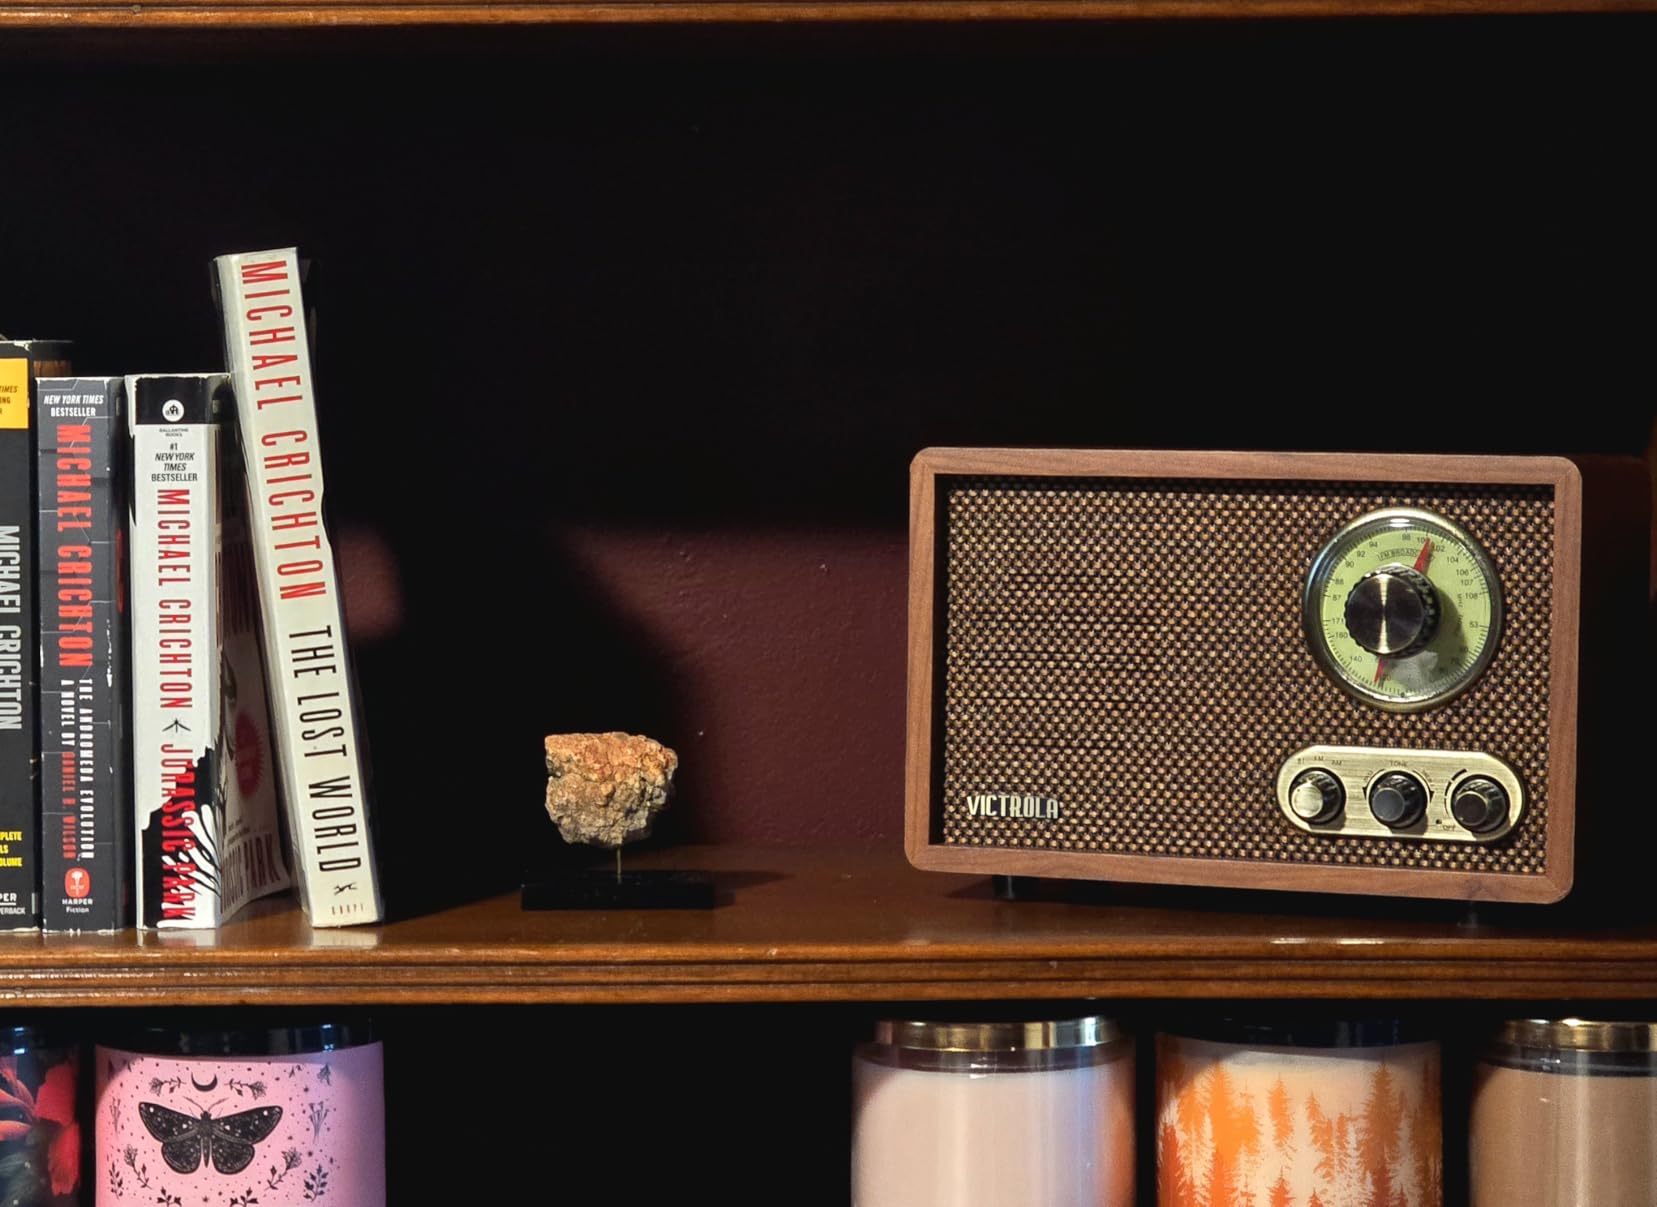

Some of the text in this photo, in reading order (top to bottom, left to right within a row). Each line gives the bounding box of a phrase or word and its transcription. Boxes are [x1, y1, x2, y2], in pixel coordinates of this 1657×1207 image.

[44, 395, 104, 405] NEW YORK TIMES
[50, 407, 96, 417] BESTSELLER
[170, 442, 178, 451] #1
[241, 260, 327, 600] MICHAEL CRICHTON
[155, 452, 195, 461] NEW YORK
[164, 463, 187, 472] TIMES
[151, 473, 198, 482] BESTSELLER
[57, 425, 94, 667] MICHAEL CRICHTON
[157, 489, 193, 709] MICHAEL CRICHTON
[289, 625, 337, 679] THE
[0, 625, 22, 730] CRICHTON
[61, 692, 75, 726] NOVEL
[297, 691, 348, 758] LOST
[61, 732, 75, 746] BY
[79, 679, 95, 859] THE ANDROMEDA EVOLUTION
[967, 794, 1058, 819] VICTROLA
[0, 831, 23, 841] PLETE
[160, 744, 197, 920] JURASSIC PARK
[308, 775, 363, 873] WORLD
